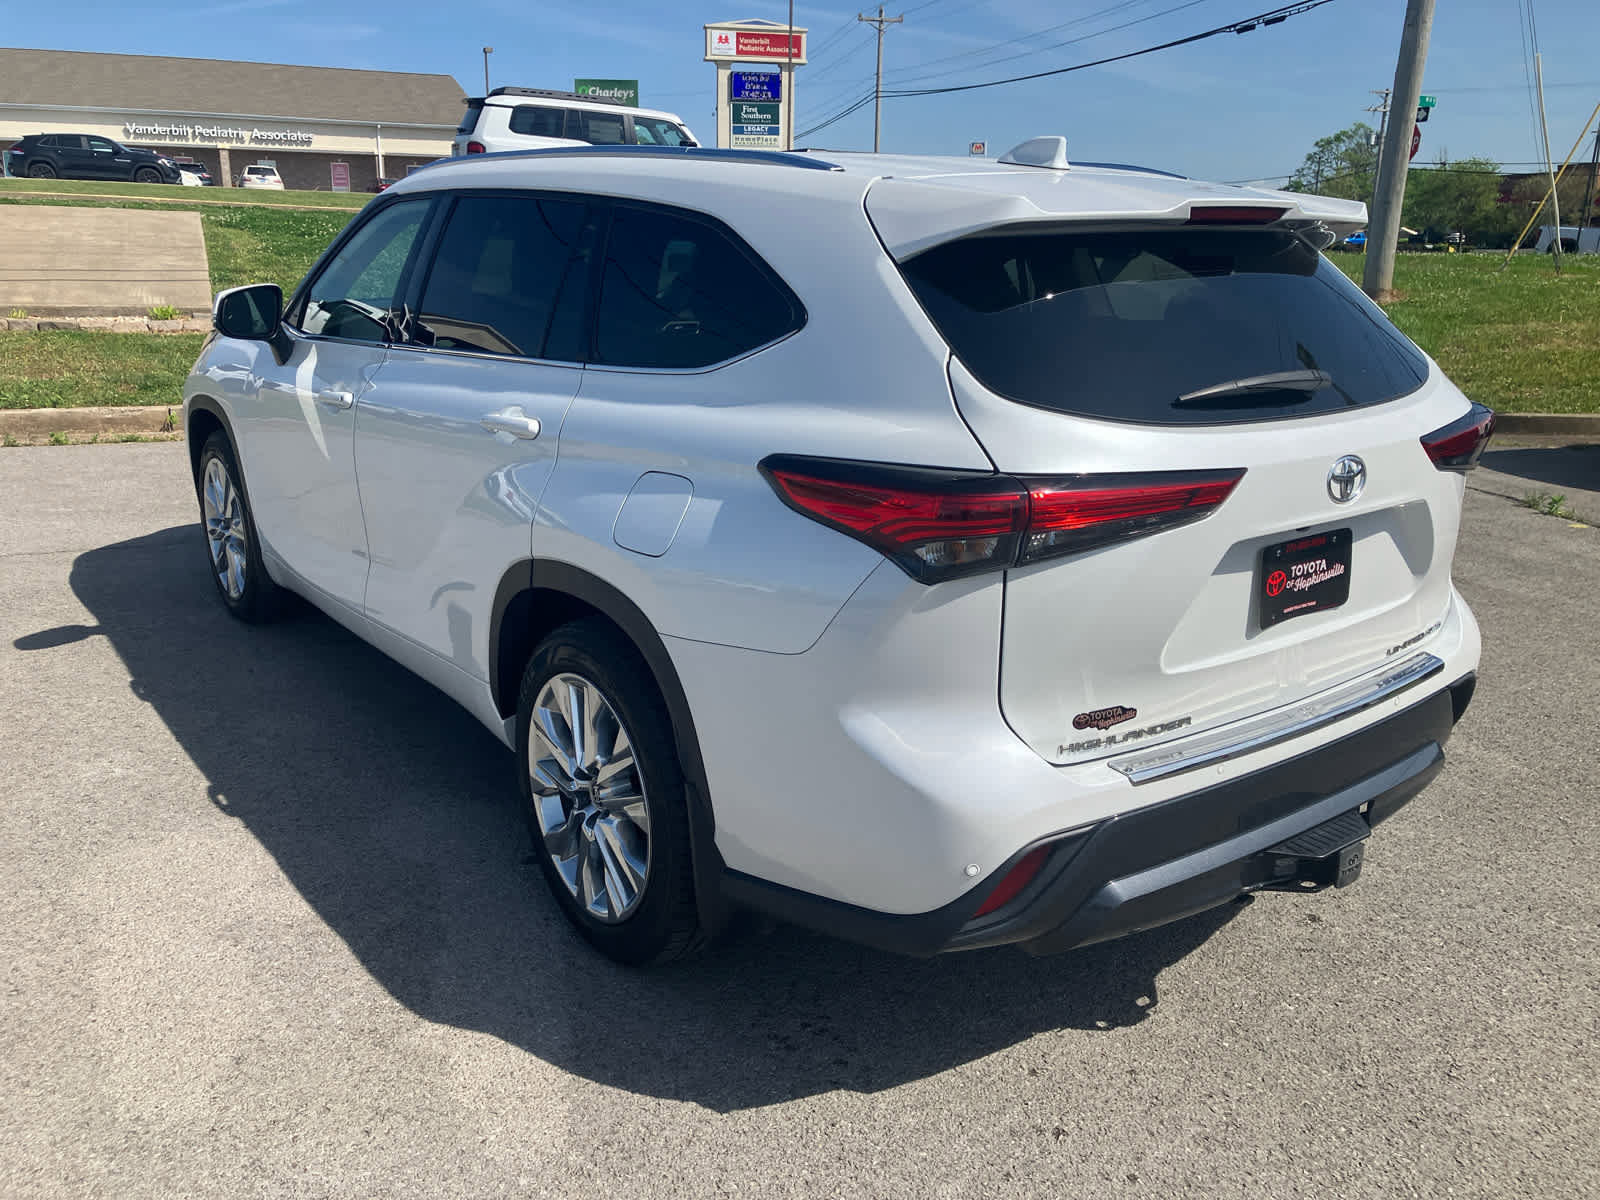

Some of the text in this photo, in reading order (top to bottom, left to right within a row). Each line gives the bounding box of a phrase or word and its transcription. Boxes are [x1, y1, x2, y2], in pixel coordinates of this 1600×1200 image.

[739, 37, 770, 45] Vanderbilt
[739, 44, 767, 53] Pediatric
[766, 45, 798, 54] Associaes
[741, 111, 771, 119] Southern
[742, 104, 758, 114] First
[126, 122, 313, 142] Vanderbilt Pediatric Associates
[1291, 559, 1327, 577] TOYOTA
[1294, 562, 1345, 592] Hopkinsville
[1090, 707, 1123, 720] TOYOTA
[1057, 716, 1192, 755] HIGHLANDER
